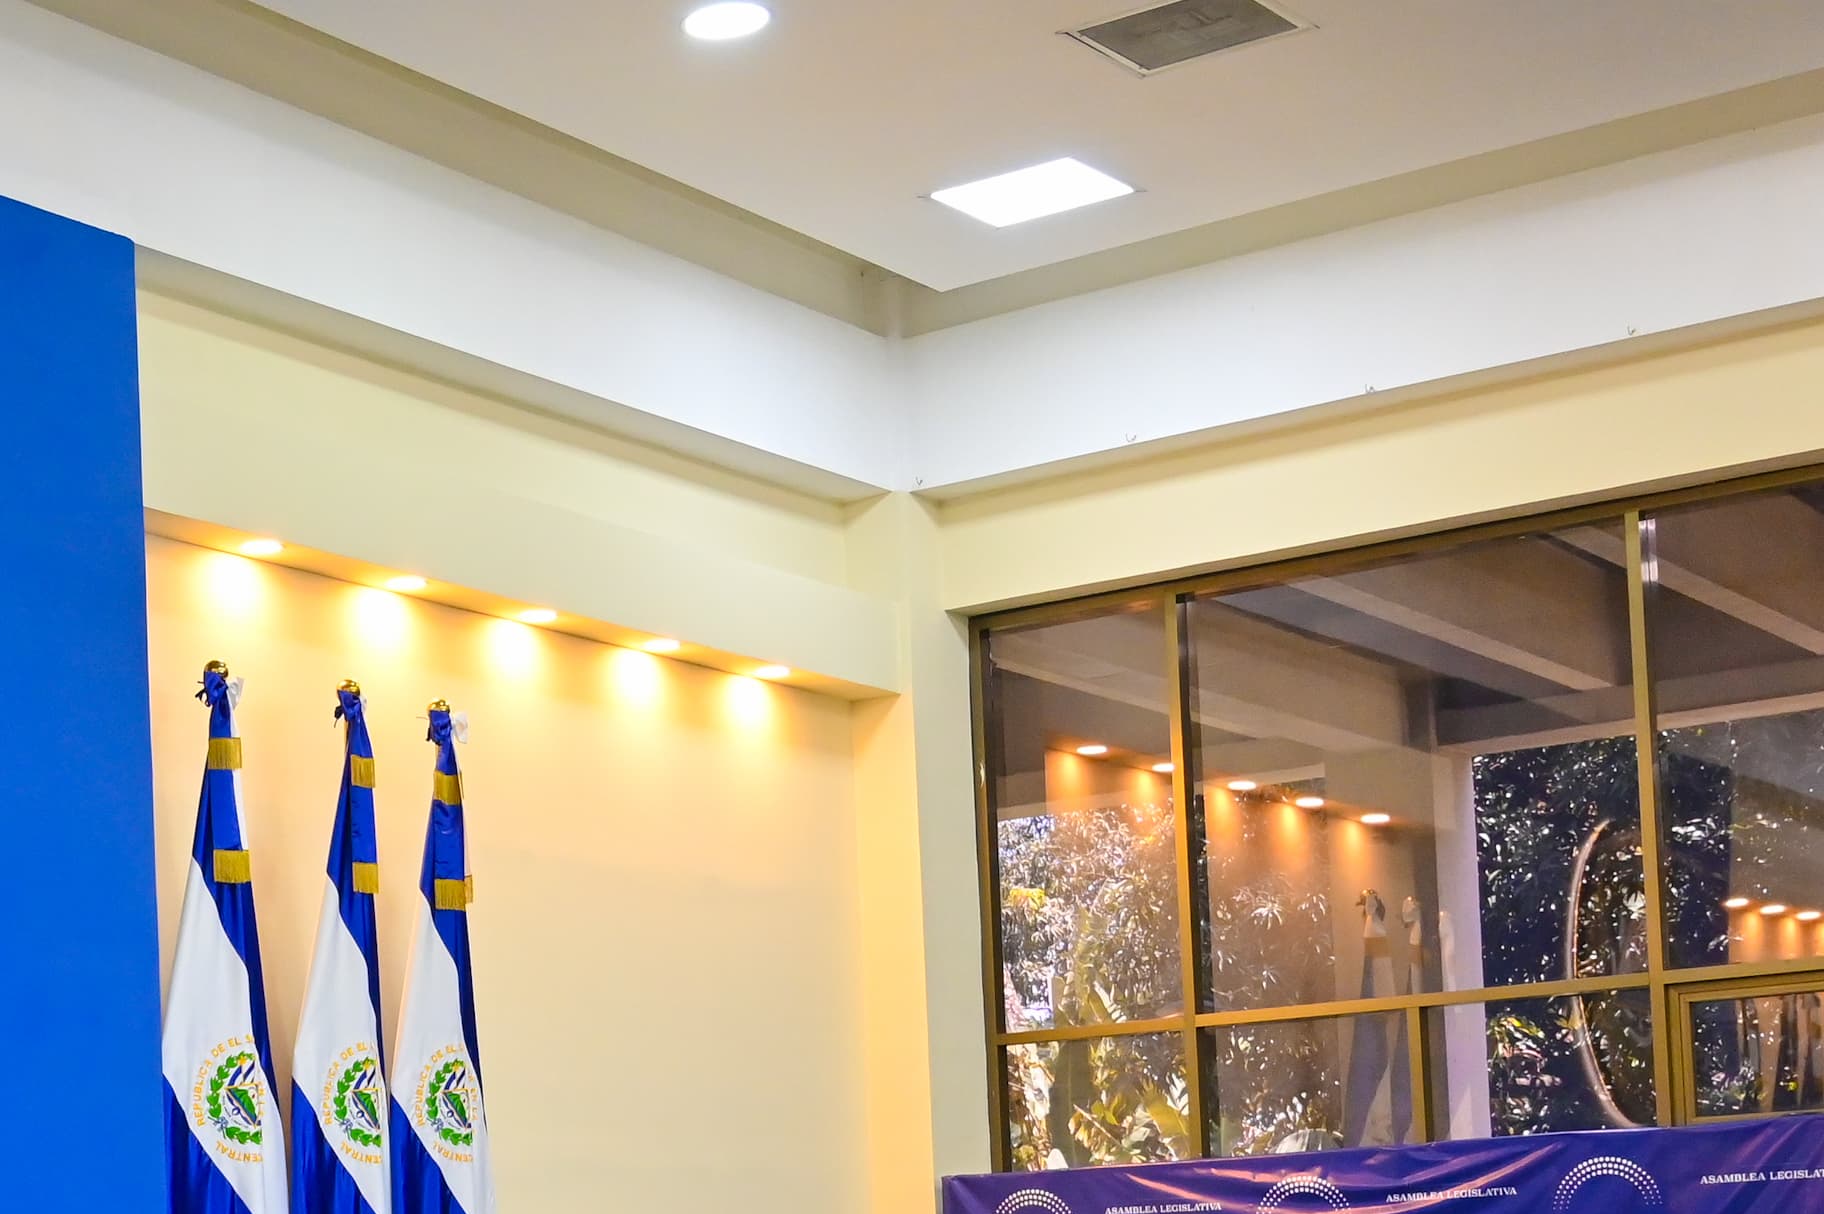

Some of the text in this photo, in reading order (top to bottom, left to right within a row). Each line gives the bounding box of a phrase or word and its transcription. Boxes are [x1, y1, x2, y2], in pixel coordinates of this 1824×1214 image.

[1700, 1172, 1766, 1185] ASAMBLEA
[1385, 1186, 1518, 1203] ASAMBLEA LEGISLATIVA
[1160, 1201, 1222, 1214] LEGISLATIVA
